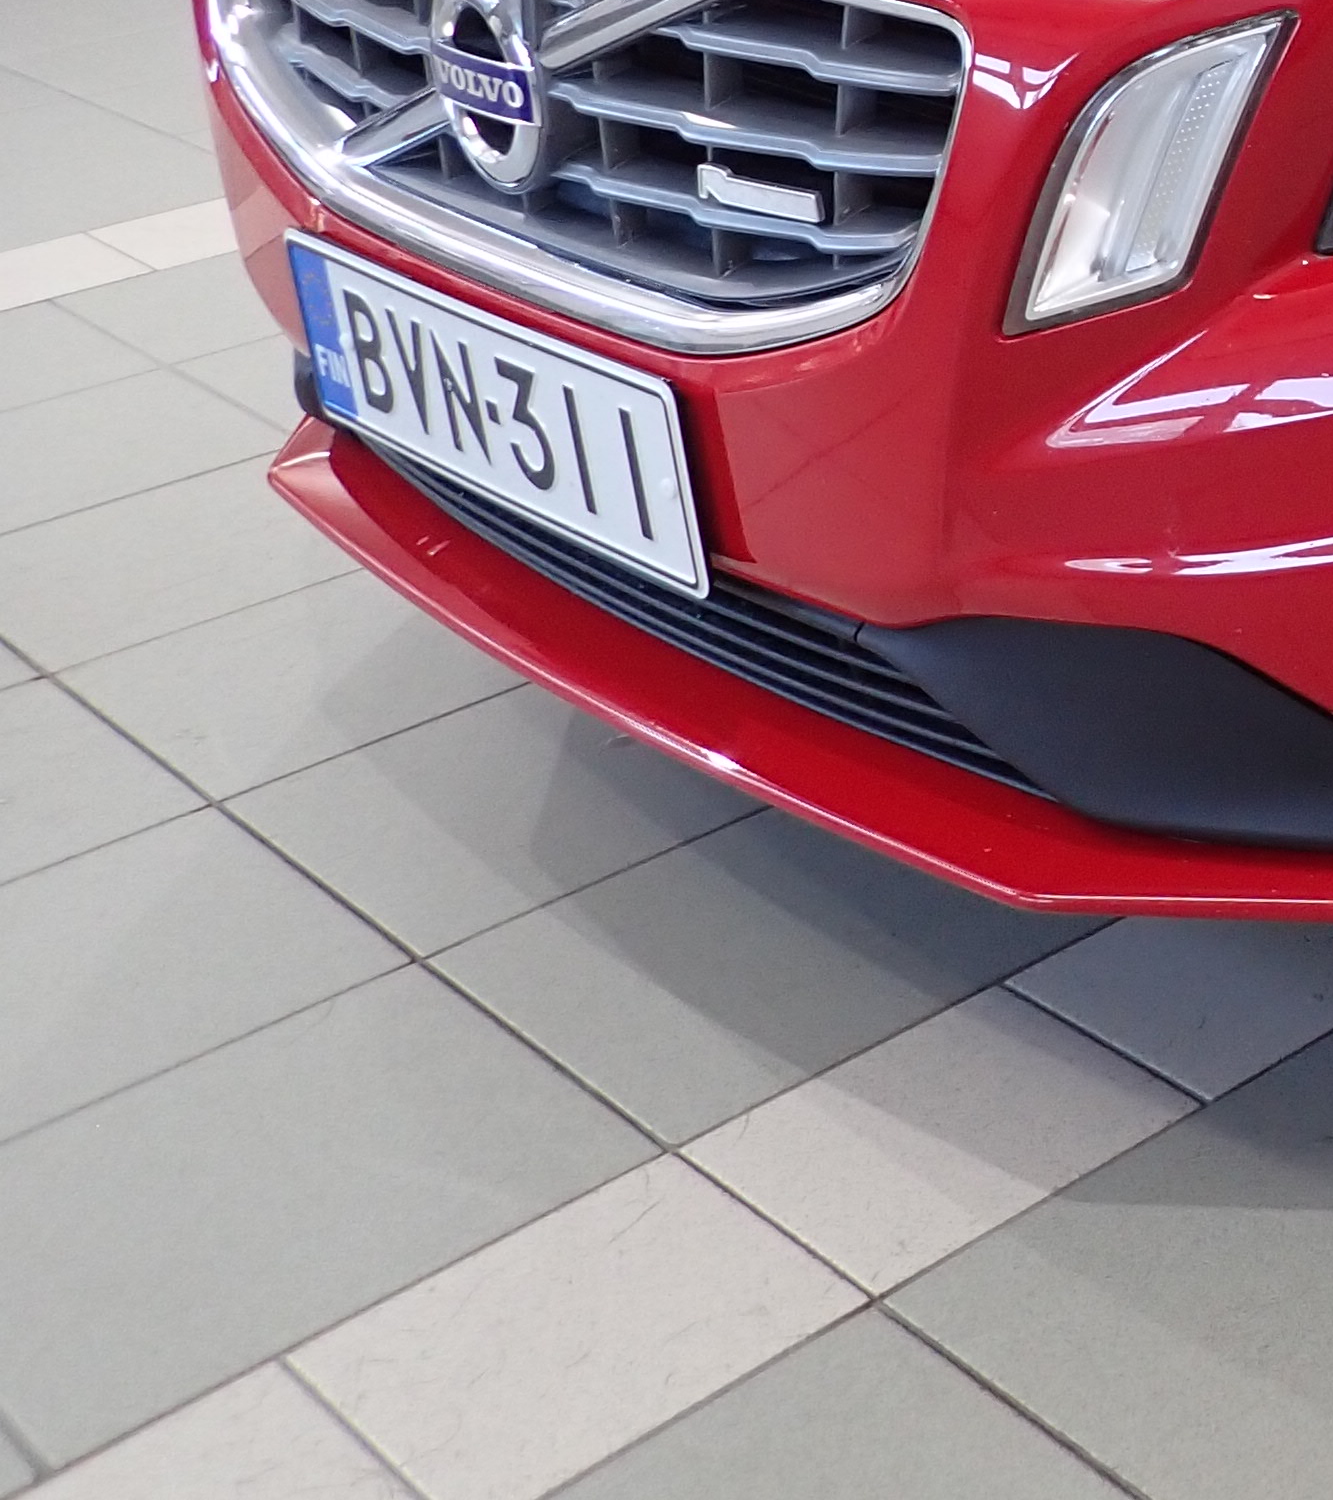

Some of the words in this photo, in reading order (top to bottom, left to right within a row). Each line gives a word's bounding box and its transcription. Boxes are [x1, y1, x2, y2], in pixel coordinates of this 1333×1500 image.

[434, 60, 525, 109] VOLVO
[314, 343, 351, 388] FIN
[342, 288, 655, 542] BVN-311
